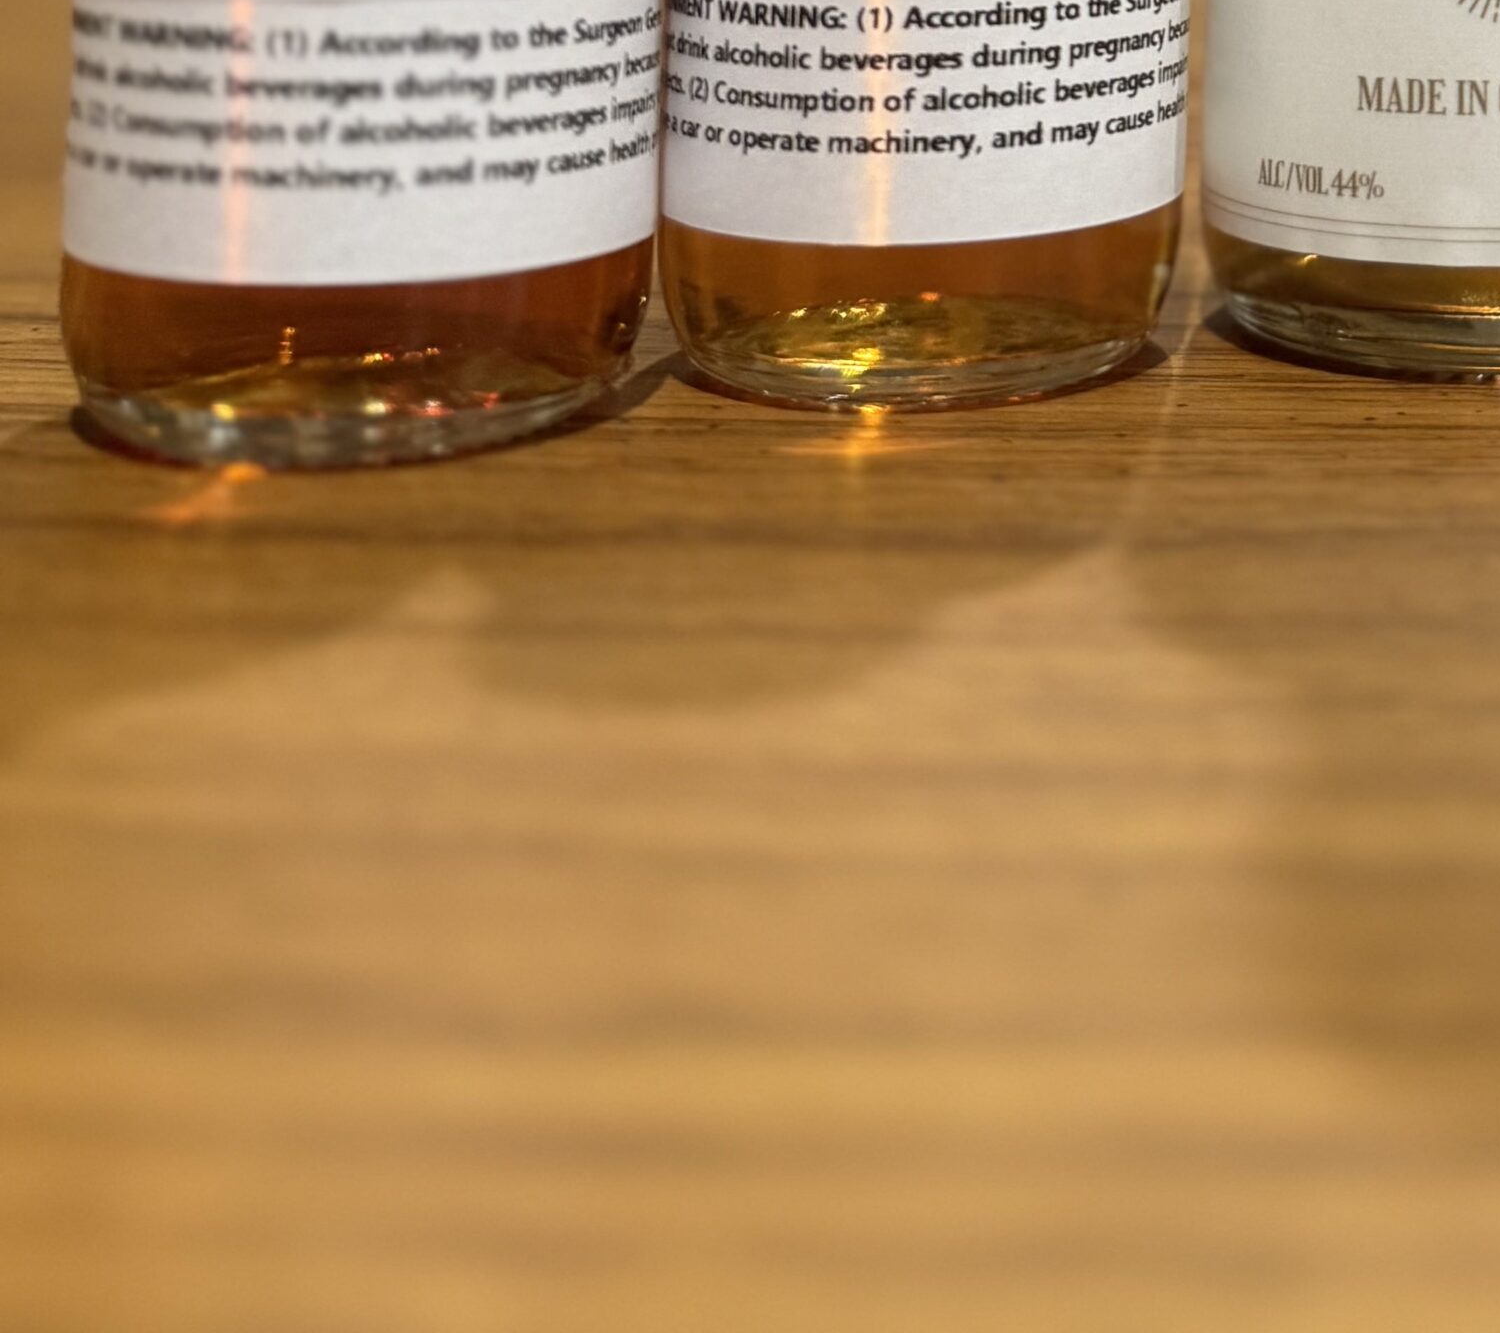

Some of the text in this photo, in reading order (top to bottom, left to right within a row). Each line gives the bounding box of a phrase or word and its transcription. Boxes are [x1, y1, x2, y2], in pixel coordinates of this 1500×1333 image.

[318, 27, 481, 60] According
[490, 26, 519, 51] to
[528, 21, 568, 47] the
[572, 14, 644, 46] Surgeon
[719, 0, 848, 31] WARNING:
[857, 5, 893, 33] (1)
[903, 1, 1047, 30] According
[1056, 0, 1080, 21] to
[713, 39, 812, 70] alcoholic
[820, 46, 963, 78] beverages
[972, 40, 1061, 69] during
[1070, 27, 1165, 68] pregnancy
[394, 71, 495, 103] during
[506, 61, 620, 98] pregnancy
[689, 75, 709, 103] (2)
[714, 81, 875, 118] Consumption
[883, 87, 918, 113] of
[923, 80, 1046, 112] alcoholic
[1055, 70, 1154, 103] beverages
[1356, 75, 1446, 115] MADE
[1456, 77, 1491, 116] IN
[488, 102, 607, 139] beverages
[705, 123, 723, 143] or
[728, 130, 820, 155] operate
[828, 129, 983, 160] machinery,
[992, 121, 1043, 149] and
[1051, 119, 1100, 146] may
[1105, 106, 1154, 135] cause
[415, 147, 605, 189] and may cause
[1258, 157, 1385, 200] ALC/VOL 44%
